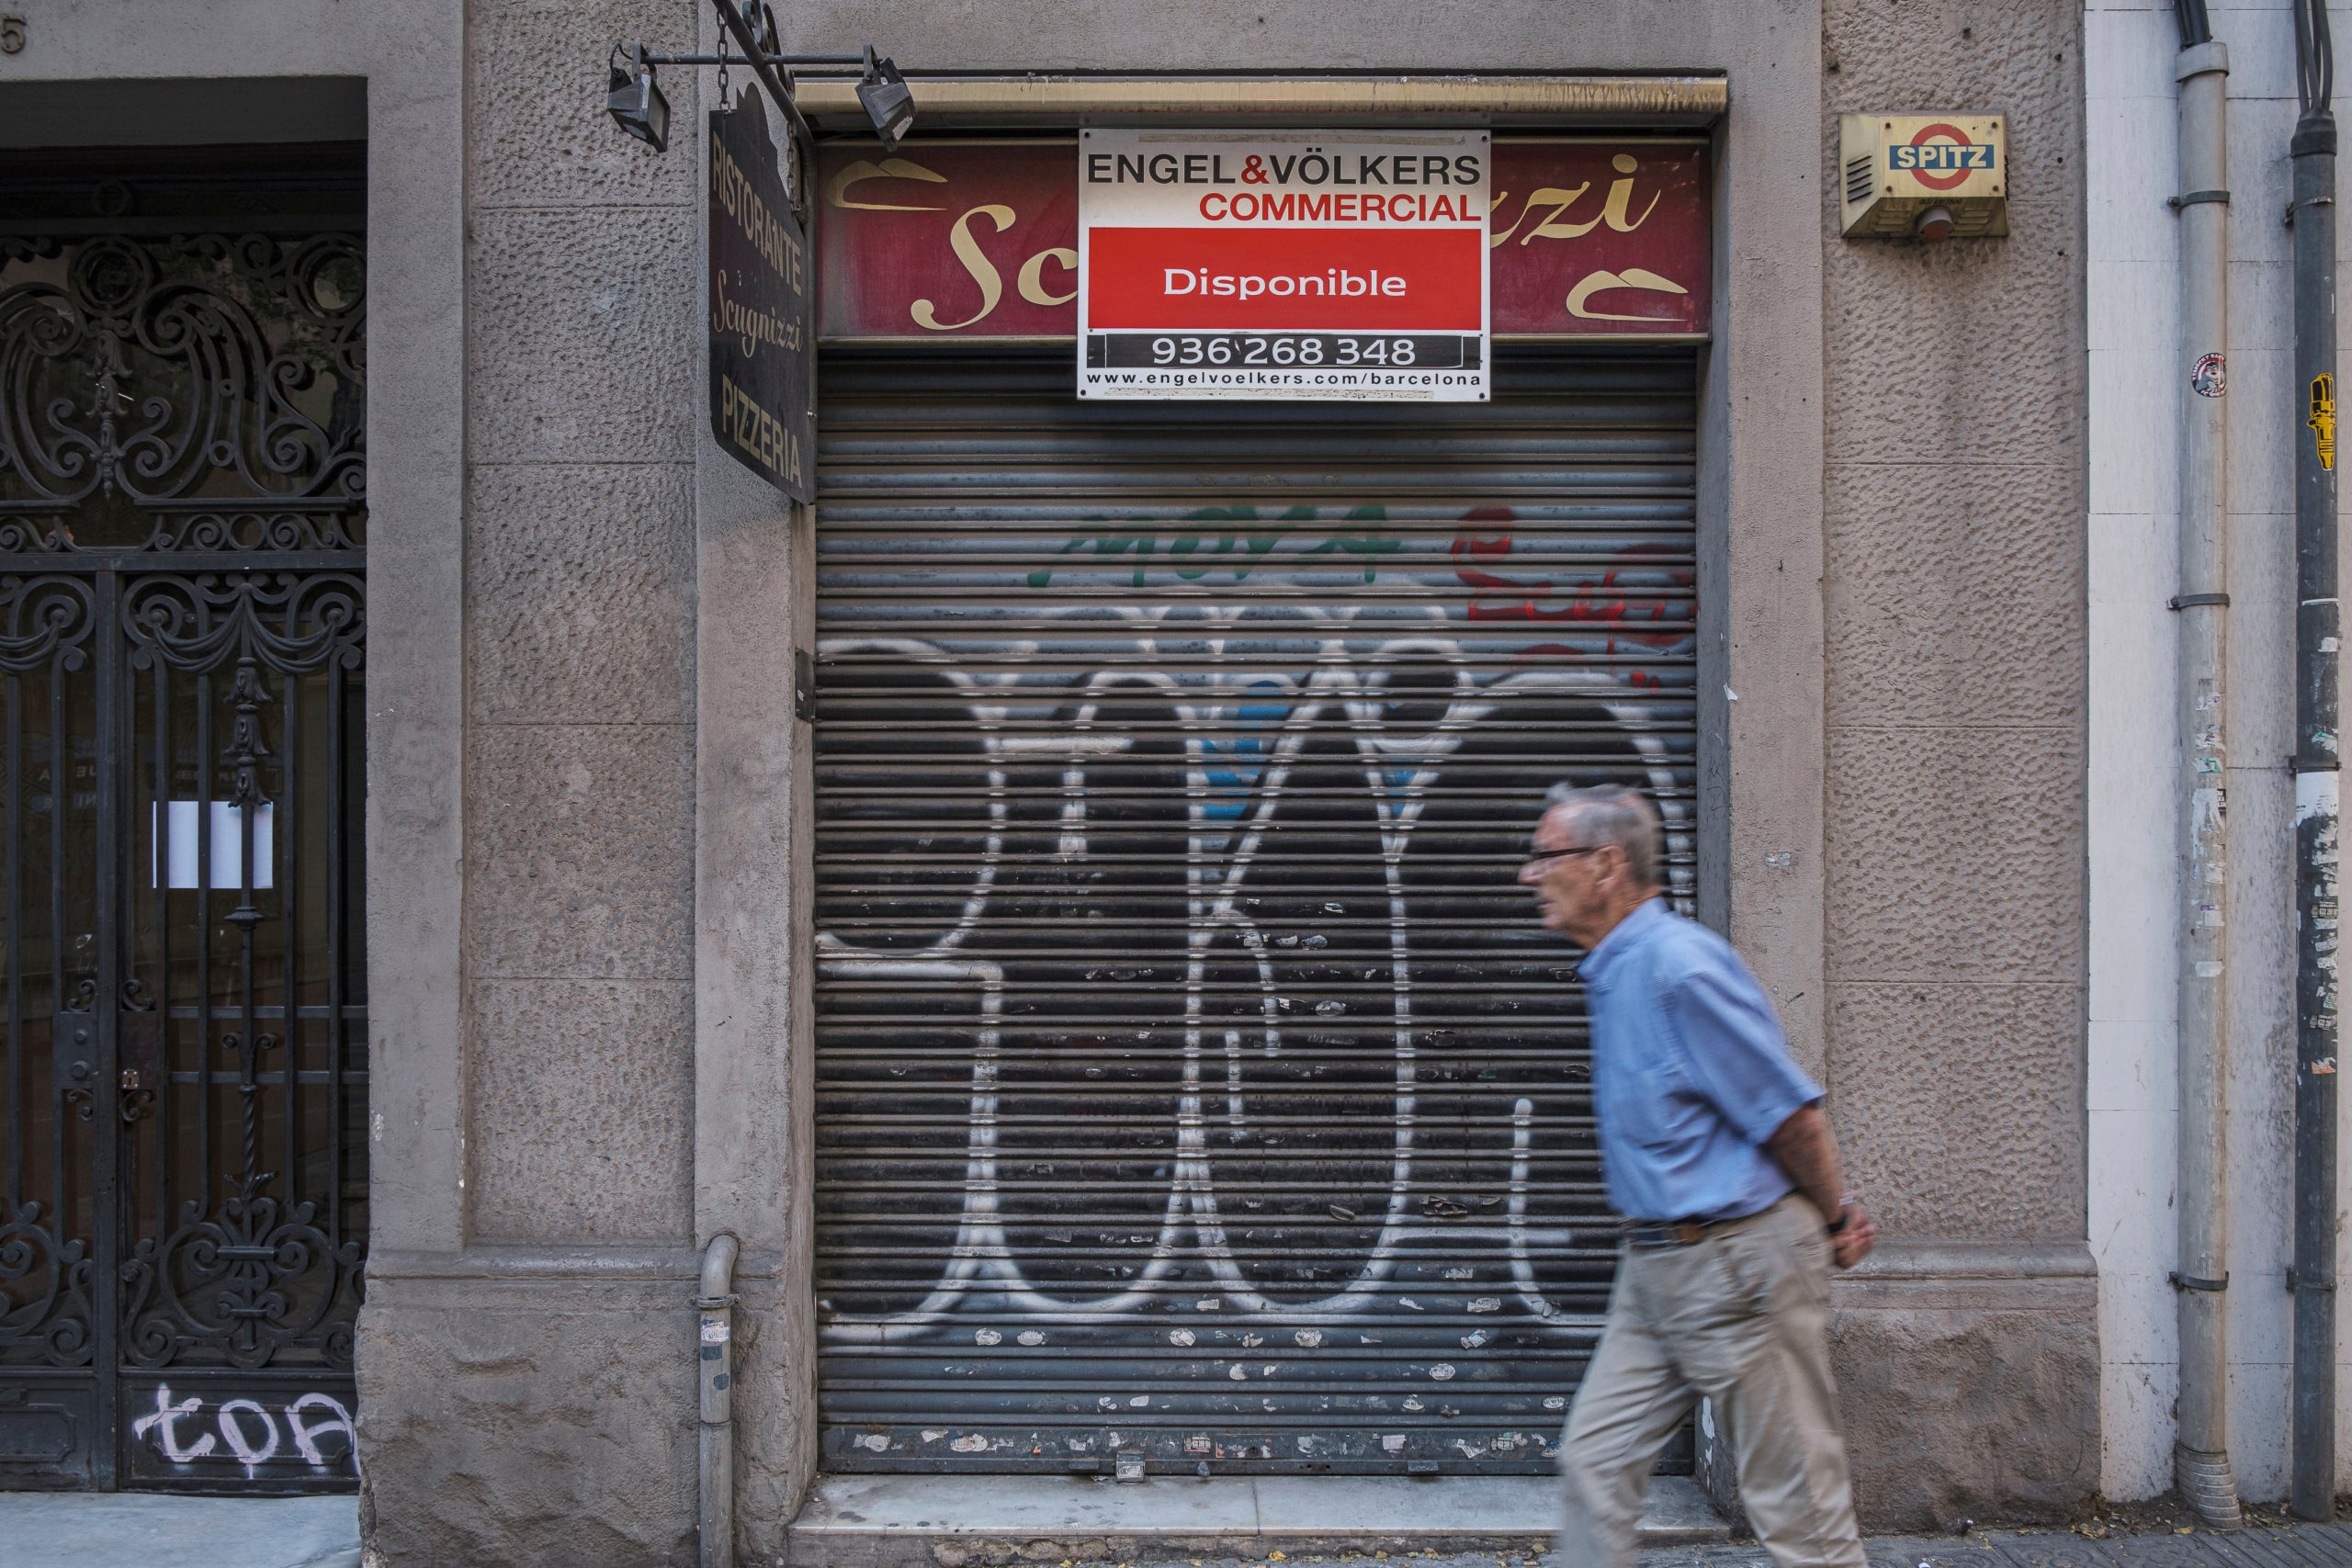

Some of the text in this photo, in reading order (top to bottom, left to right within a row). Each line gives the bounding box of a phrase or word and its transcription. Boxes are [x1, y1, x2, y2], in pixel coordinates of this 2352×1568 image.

[1087, 146, 1481, 186] ENGEL&VÖLKERS
[1897, 146, 1987, 168] SPITZ
[713, 130, 802, 298] RISTORANTE
[1199, 193, 1482, 222] COMMERCIAL
[1163, 268, 1407, 300] Disponible
[713, 268, 804, 359] Scugnizzi
[1152, 337, 1416, 367] 936 268 348
[1086, 371, 1481, 387] www.engelvoelkers.com/barcelona
[722, 373, 803, 490] PIZZERIA
